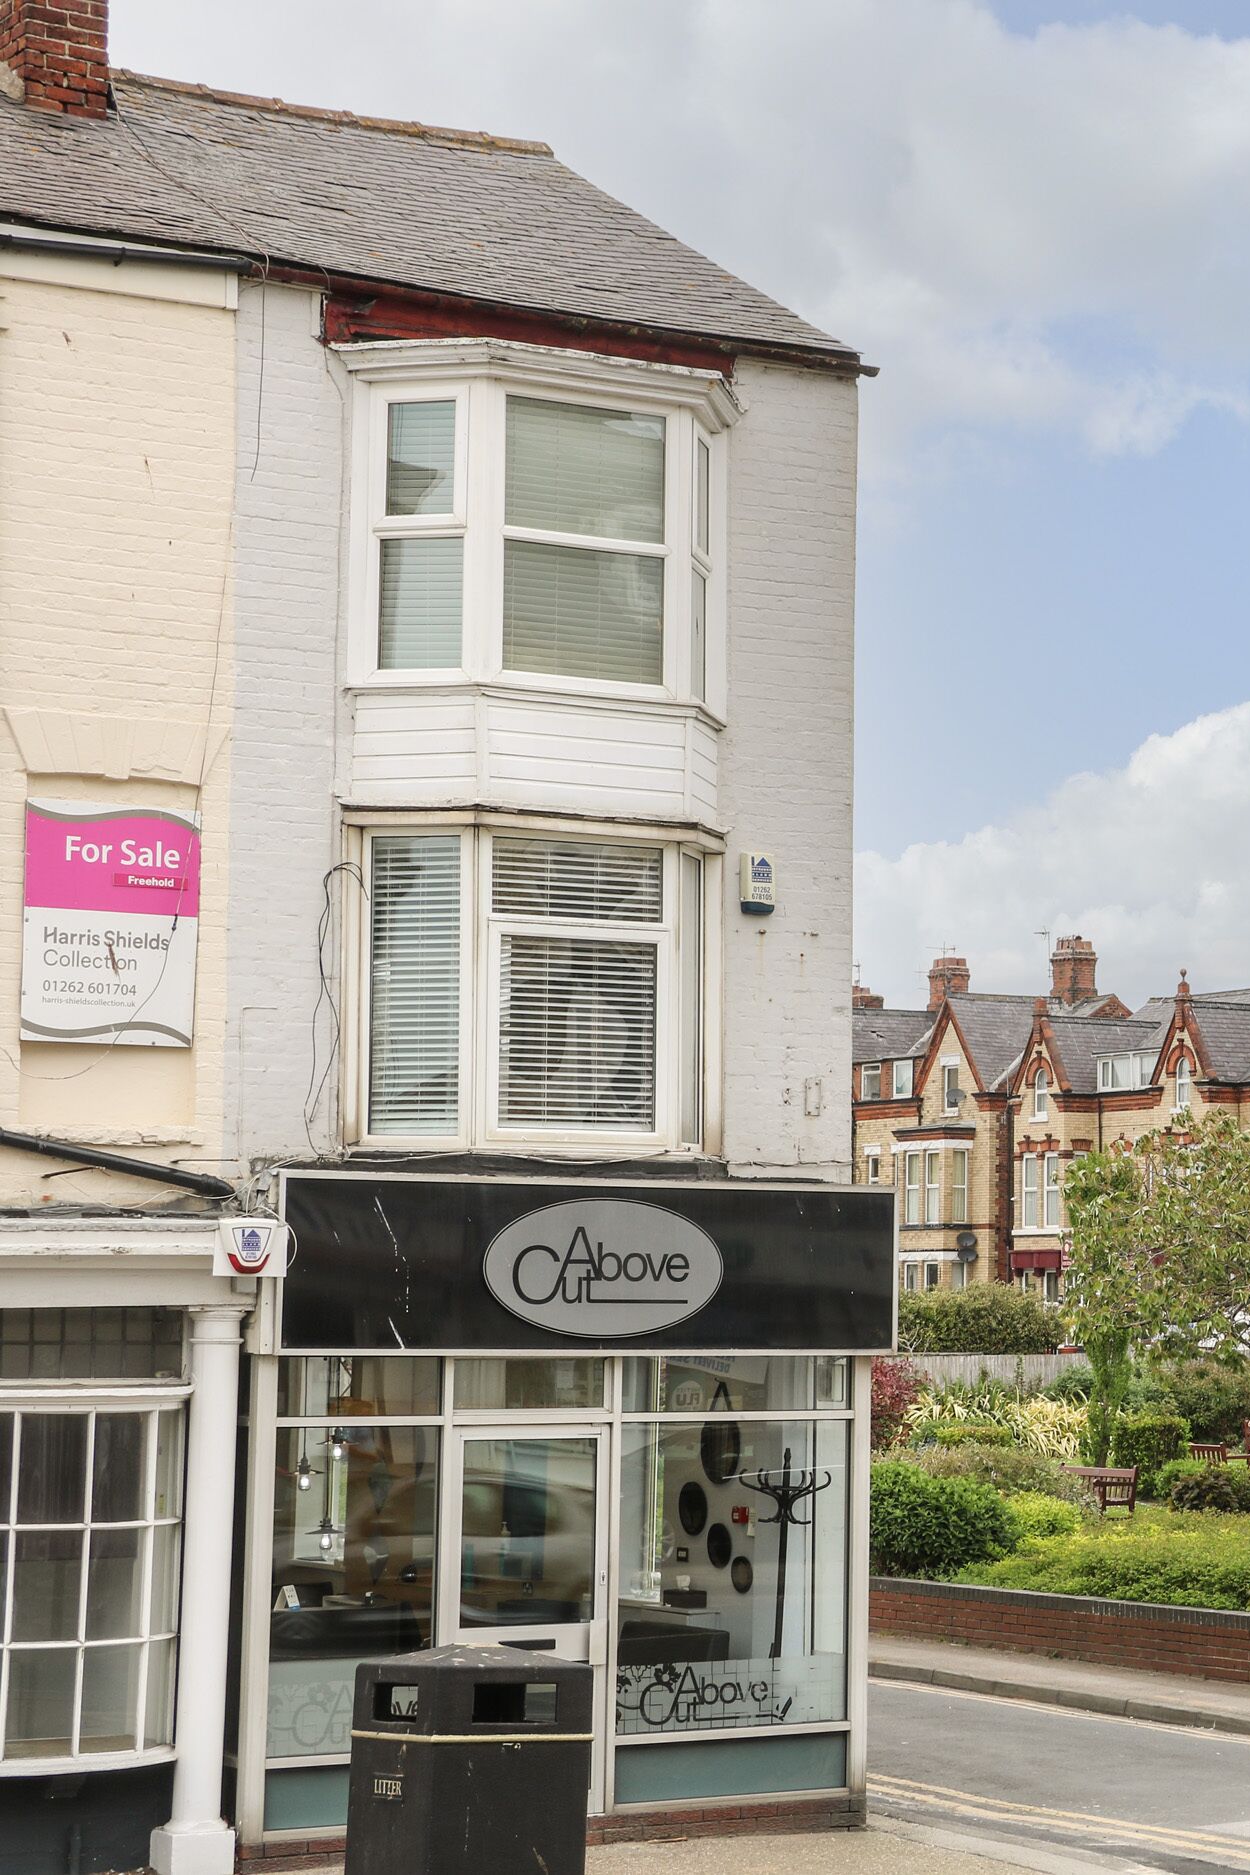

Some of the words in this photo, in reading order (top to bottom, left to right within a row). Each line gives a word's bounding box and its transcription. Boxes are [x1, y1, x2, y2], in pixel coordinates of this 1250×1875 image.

[65, 835, 112, 864] For
[120, 840, 180, 869] Sale
[127, 875, 174, 888] Freehold
[44, 926, 100, 947] Harris
[104, 930, 169, 951] Shields
[43, 979, 84, 994] 01262
[88, 981, 137, 996] 601704
[512, 1244, 602, 1305] Cut
[561, 1226, 690, 1283] Above
[676, 1665, 768, 1706] Above
[374, 1778, 402, 1796] LITTER
